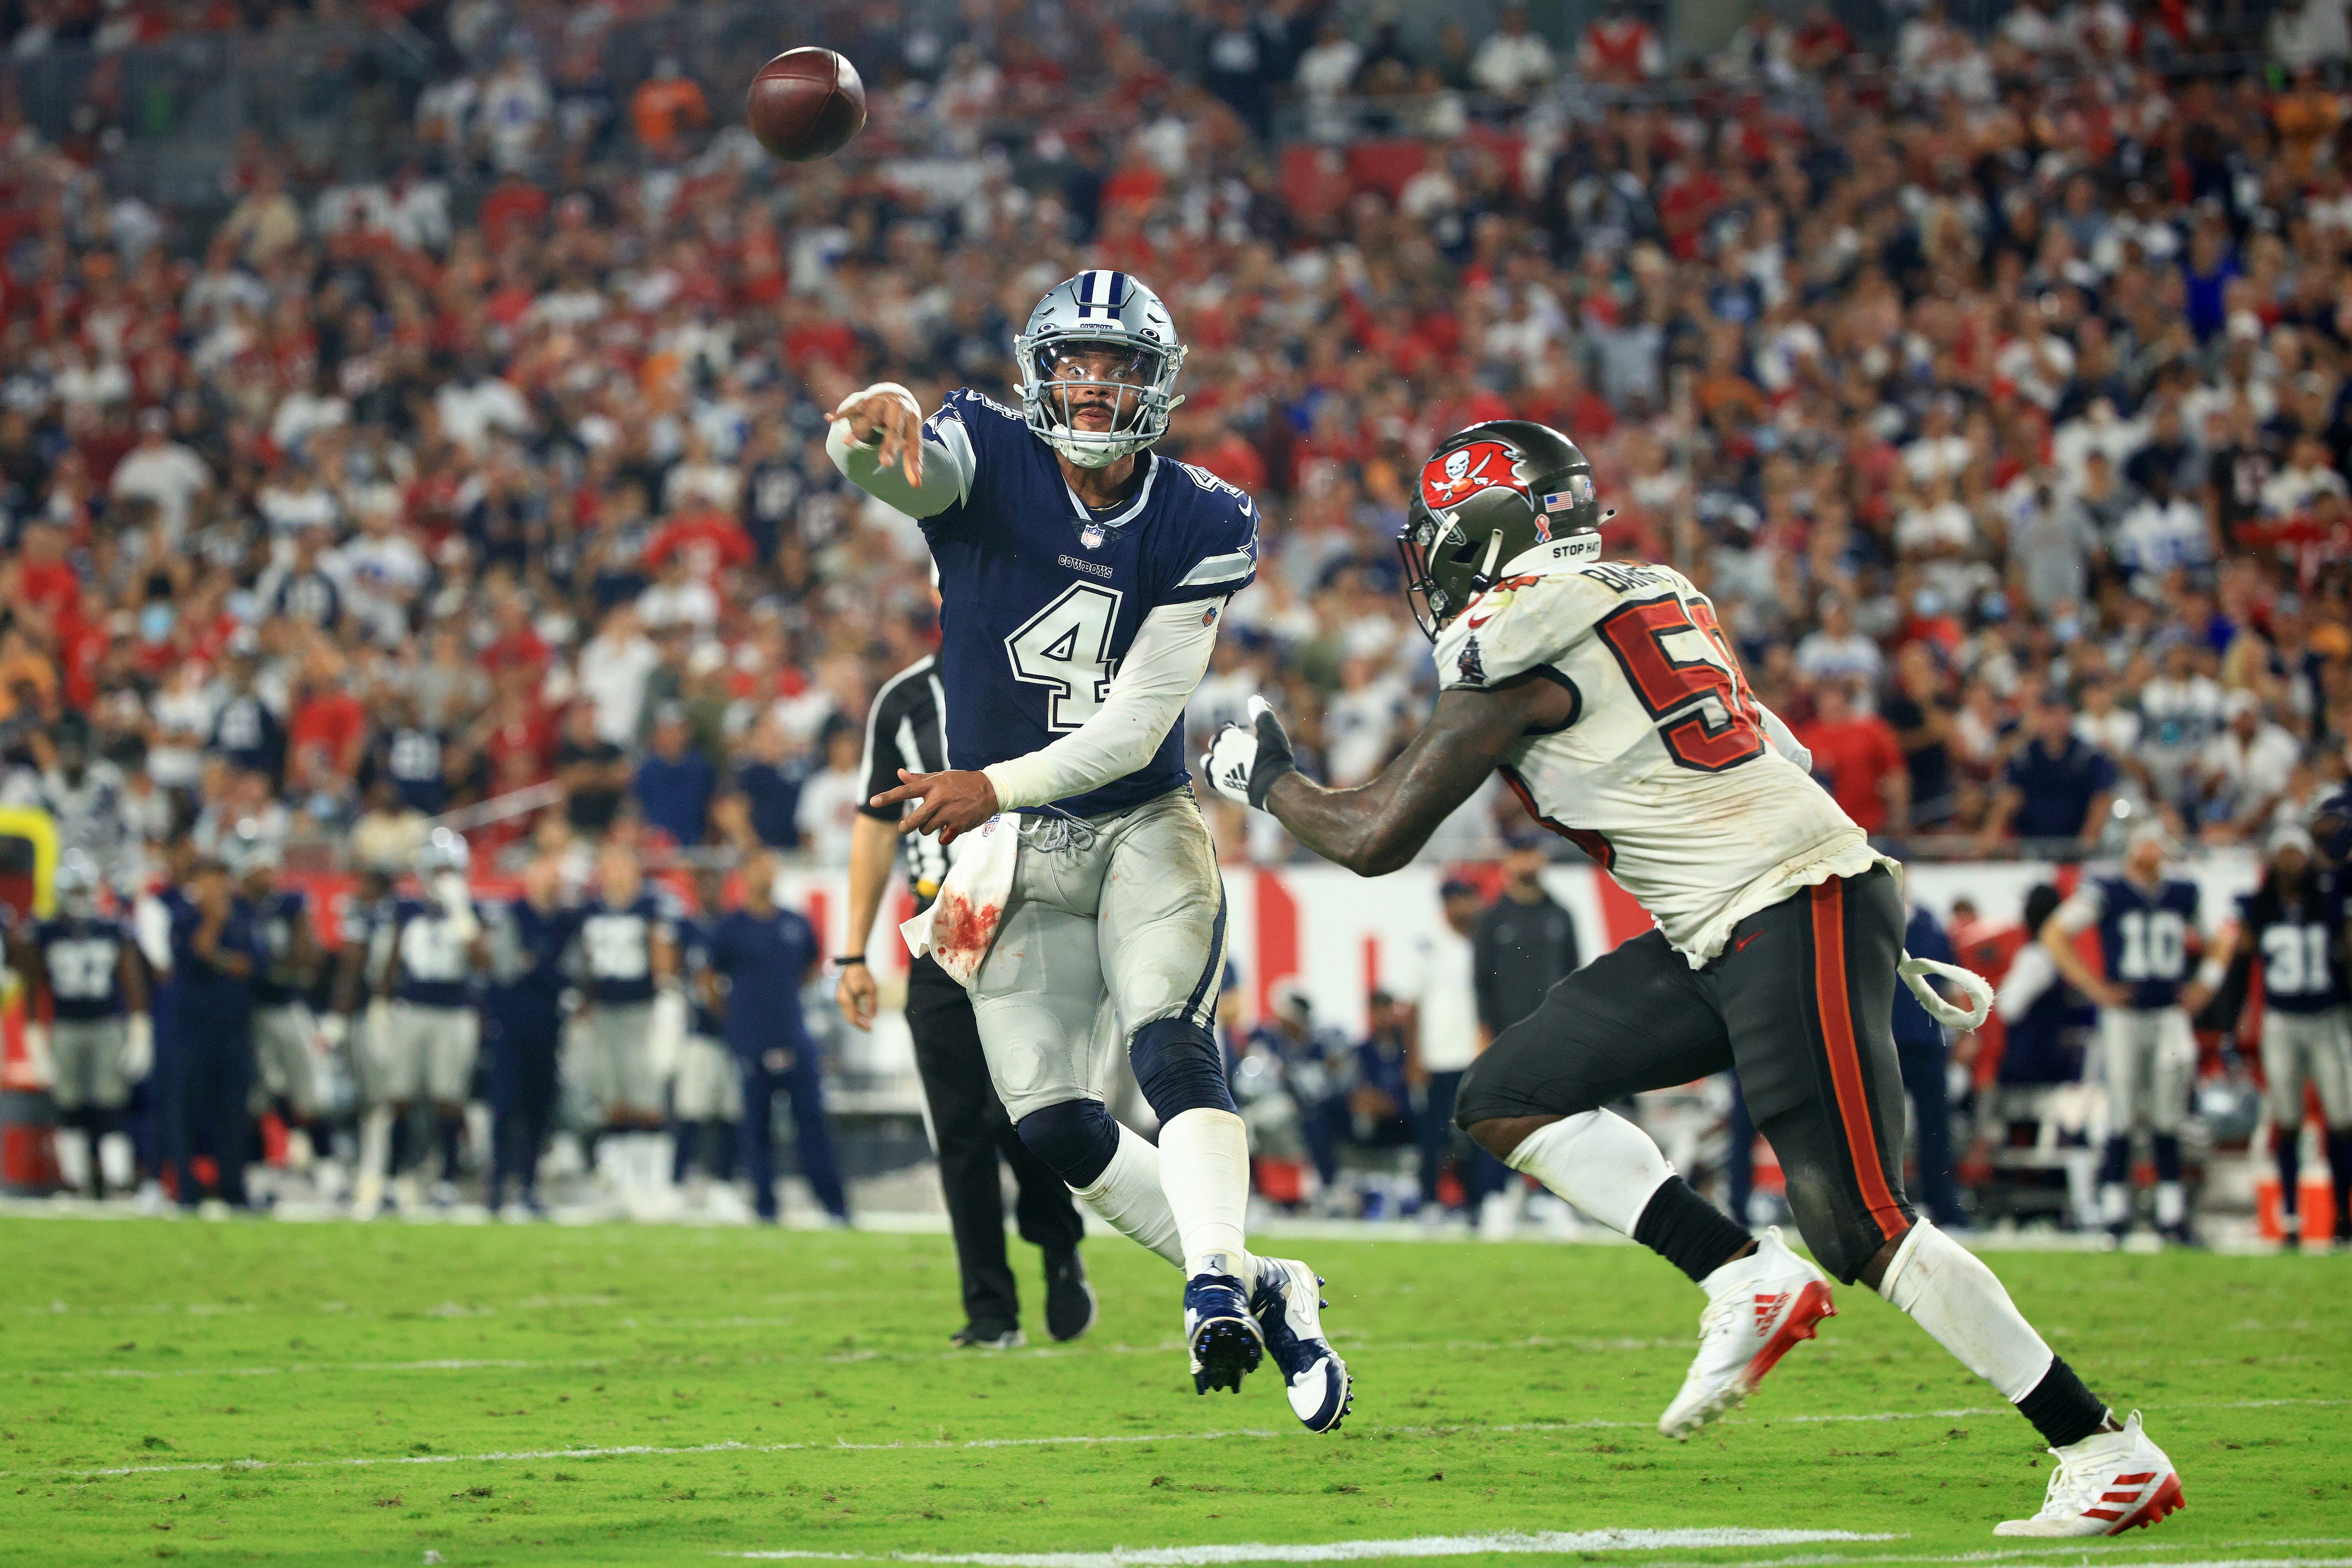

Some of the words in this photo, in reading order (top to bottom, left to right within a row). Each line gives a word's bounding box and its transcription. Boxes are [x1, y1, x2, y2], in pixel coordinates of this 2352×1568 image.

[1058, 554, 1113, 579] COWBOYS
[1553, 544, 1584, 558] STOP
[1003, 580, 1123, 732] 4
[982, 822, 995, 835] NFL
[2119, 910, 2188, 979] 10
[2261, 921, 2332, 997] 31
